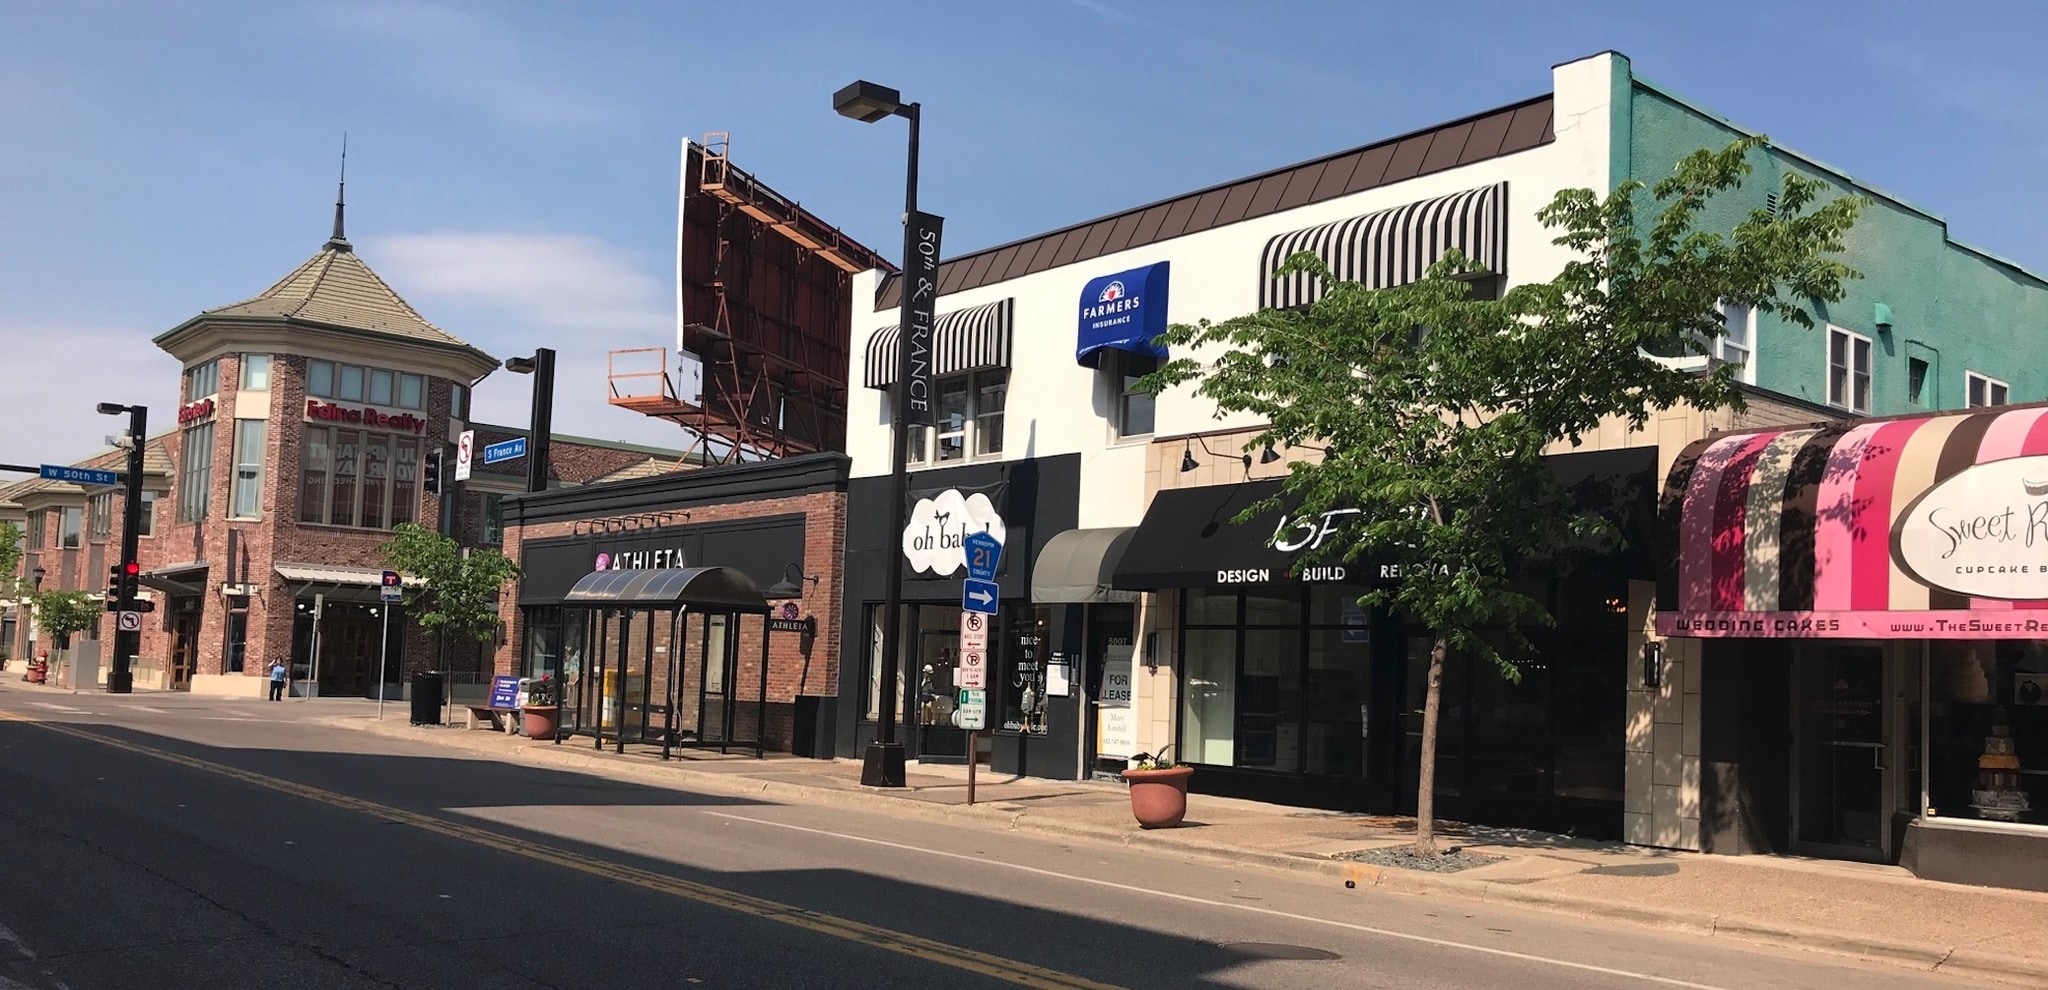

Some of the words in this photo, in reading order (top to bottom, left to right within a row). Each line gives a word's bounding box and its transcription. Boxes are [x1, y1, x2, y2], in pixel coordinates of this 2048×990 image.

[917, 227, 936, 271] 50th
[911, 276, 933, 303] &
[1083, 296, 1140, 320] FARMERS
[1092, 315, 1131, 329] INSURANCE
[910, 308, 930, 412] FRANCE
[307, 400, 362, 423] Edina
[364, 407, 426, 435] Realty
[488, 450, 492, 459] S
[493, 446, 512, 458] France
[514, 443, 522, 453] Av
[48, 468, 58, 477] W
[64, 470, 90, 481] 50th
[96, 473, 108, 482] St
[913, 525, 934, 550] oh
[1928, 506, 2016, 559] Sweet
[612, 548, 685, 569] ATHLETA
[973, 547, 991, 568] 21
[972, 568, 991, 577] COUNTY
[1217, 569, 1270, 583] DESIGN
[1302, 567, 1346, 581] BUILD
[1955, 565, 2029, 574] CUPCAKE
[772, 621, 808, 631] ATHLETA
[1675, 619, 1764, 632] WEDDING
[1774, 619, 1840, 632] CAKES
[1108, 637, 1128, 646] 5007
[1024, 649, 1033, 659] to
[1018, 661, 1038, 671] meet
[1109, 674, 1128, 686] FOR
[1104, 690, 1131, 701] LEASE
